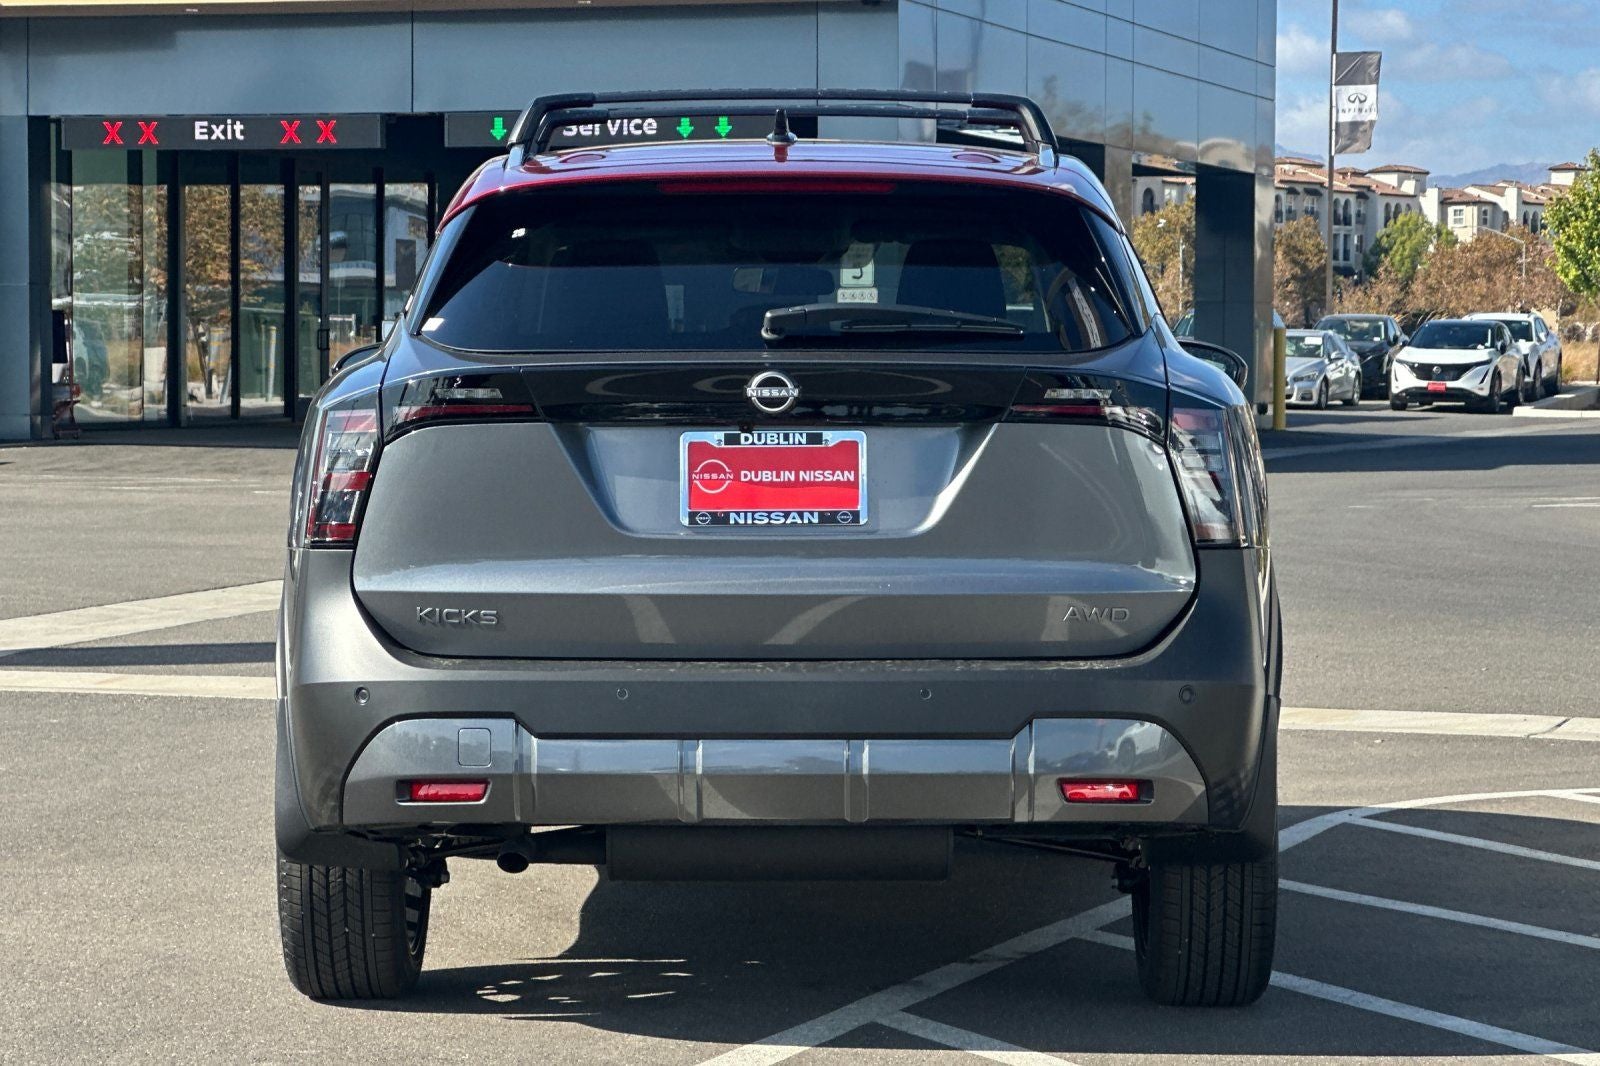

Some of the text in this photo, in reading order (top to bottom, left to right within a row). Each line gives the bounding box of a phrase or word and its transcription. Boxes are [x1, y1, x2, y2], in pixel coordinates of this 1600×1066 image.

[194, 119, 245, 140] Exit
[747, 388, 799, 397] NISSAN
[740, 432, 807, 445] DUBLIN
[740, 470, 855, 482] DUBLIN NISSAN
[729, 511, 819, 524] NISSAN
[416, 606, 498, 625] KICKS
[1062, 606, 1130, 622] AWD
